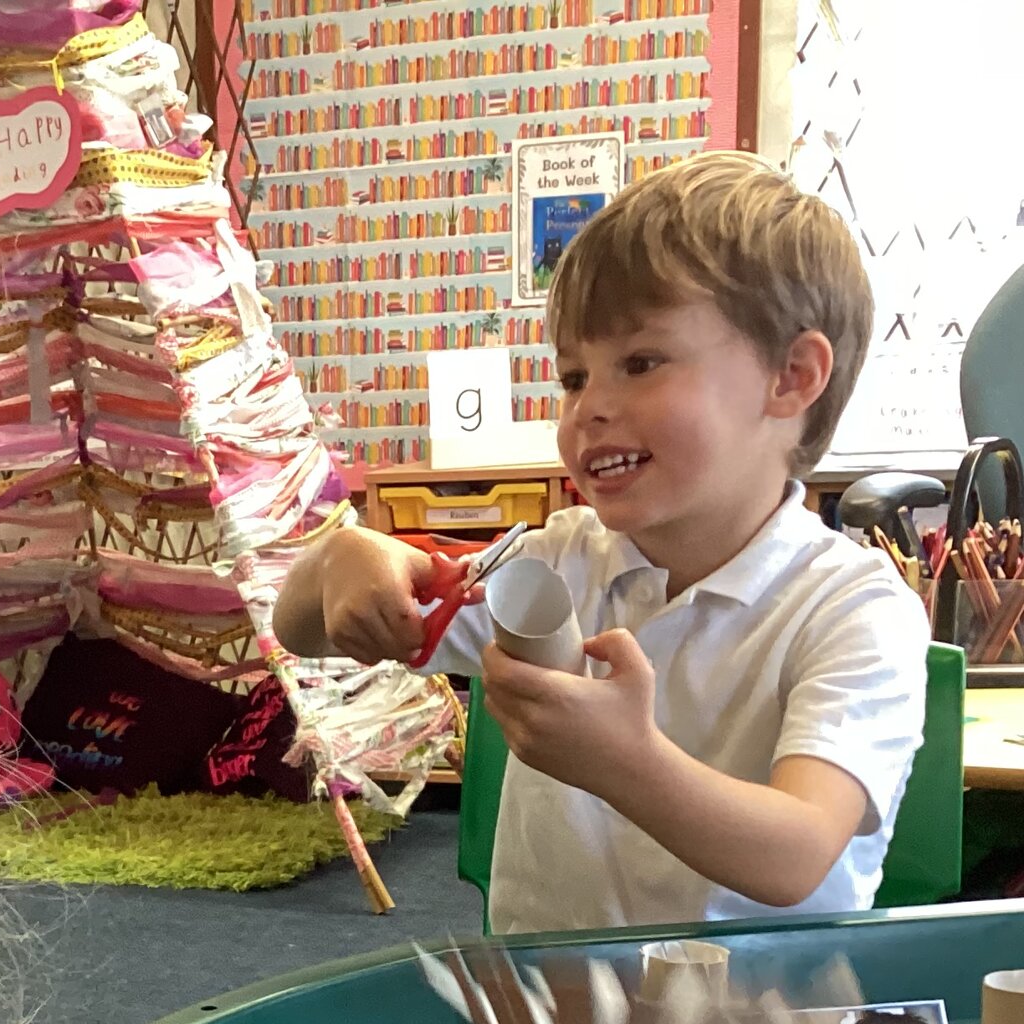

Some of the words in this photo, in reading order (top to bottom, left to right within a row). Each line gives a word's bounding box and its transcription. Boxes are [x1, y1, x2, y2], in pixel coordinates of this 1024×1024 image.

[542, 157, 575, 172] Book
[581, 154, 596, 168] of
[537, 175, 560, 189] the
[565, 172, 600, 187] Week
[456, 388, 482, 432] g
